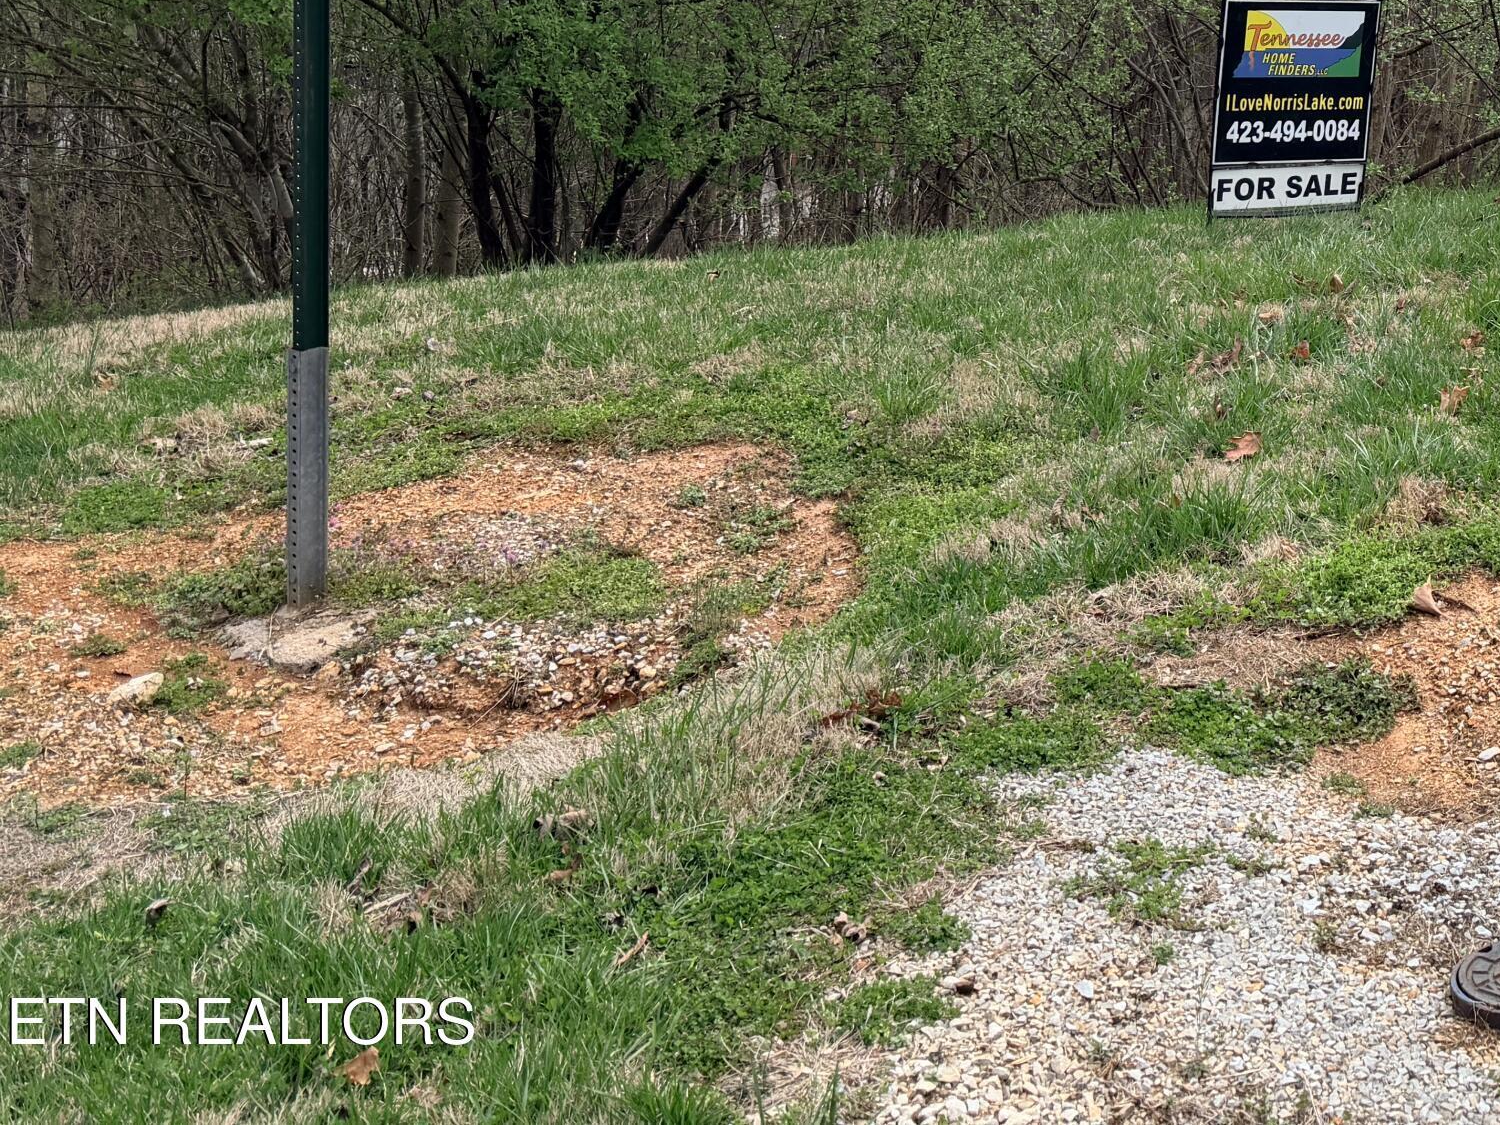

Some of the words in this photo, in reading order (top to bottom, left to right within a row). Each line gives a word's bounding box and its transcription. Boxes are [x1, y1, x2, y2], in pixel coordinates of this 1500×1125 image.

[1247, 20, 1346, 54] Tennessee
[1262, 52, 1296, 64] HOME
[1226, 119, 1360, 144] 423-494-0084
[1216, 177, 1276, 202] FOR
[1285, 172, 1358, 198] SALE
